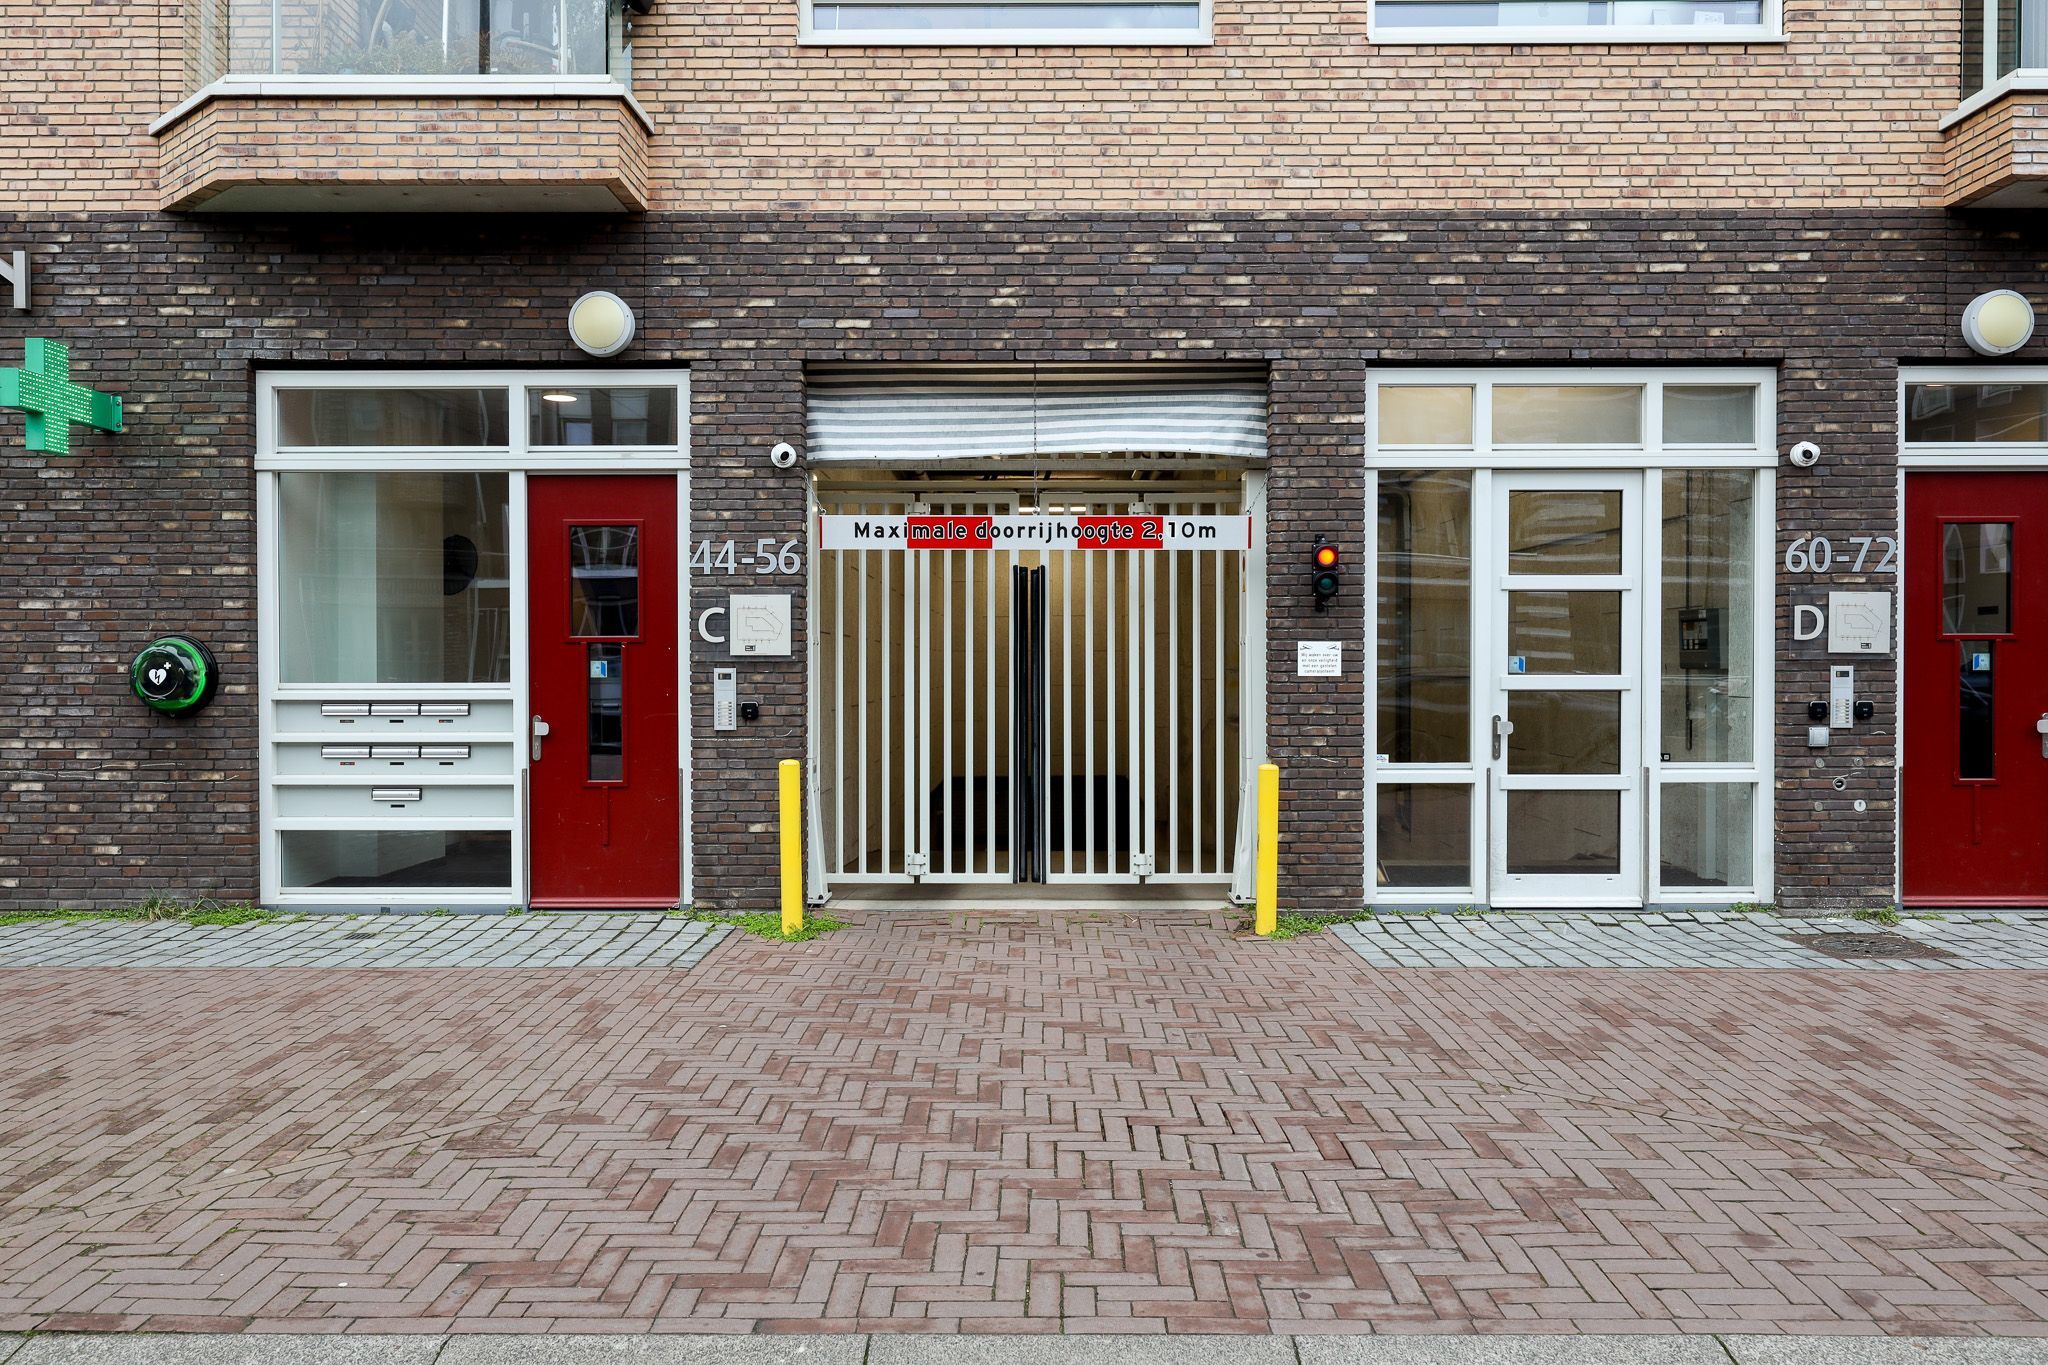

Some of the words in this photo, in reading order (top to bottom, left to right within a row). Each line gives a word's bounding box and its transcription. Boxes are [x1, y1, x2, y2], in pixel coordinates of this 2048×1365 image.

[854, 521, 967, 539] Maximale
[975, 520, 1134, 544] doorrijhoogte
[689, 538, 801, 575] 44-56
[1785, 536, 1898, 573] 60-72
[698, 606, 726, 643] C
[1794, 604, 1825, 641] D
